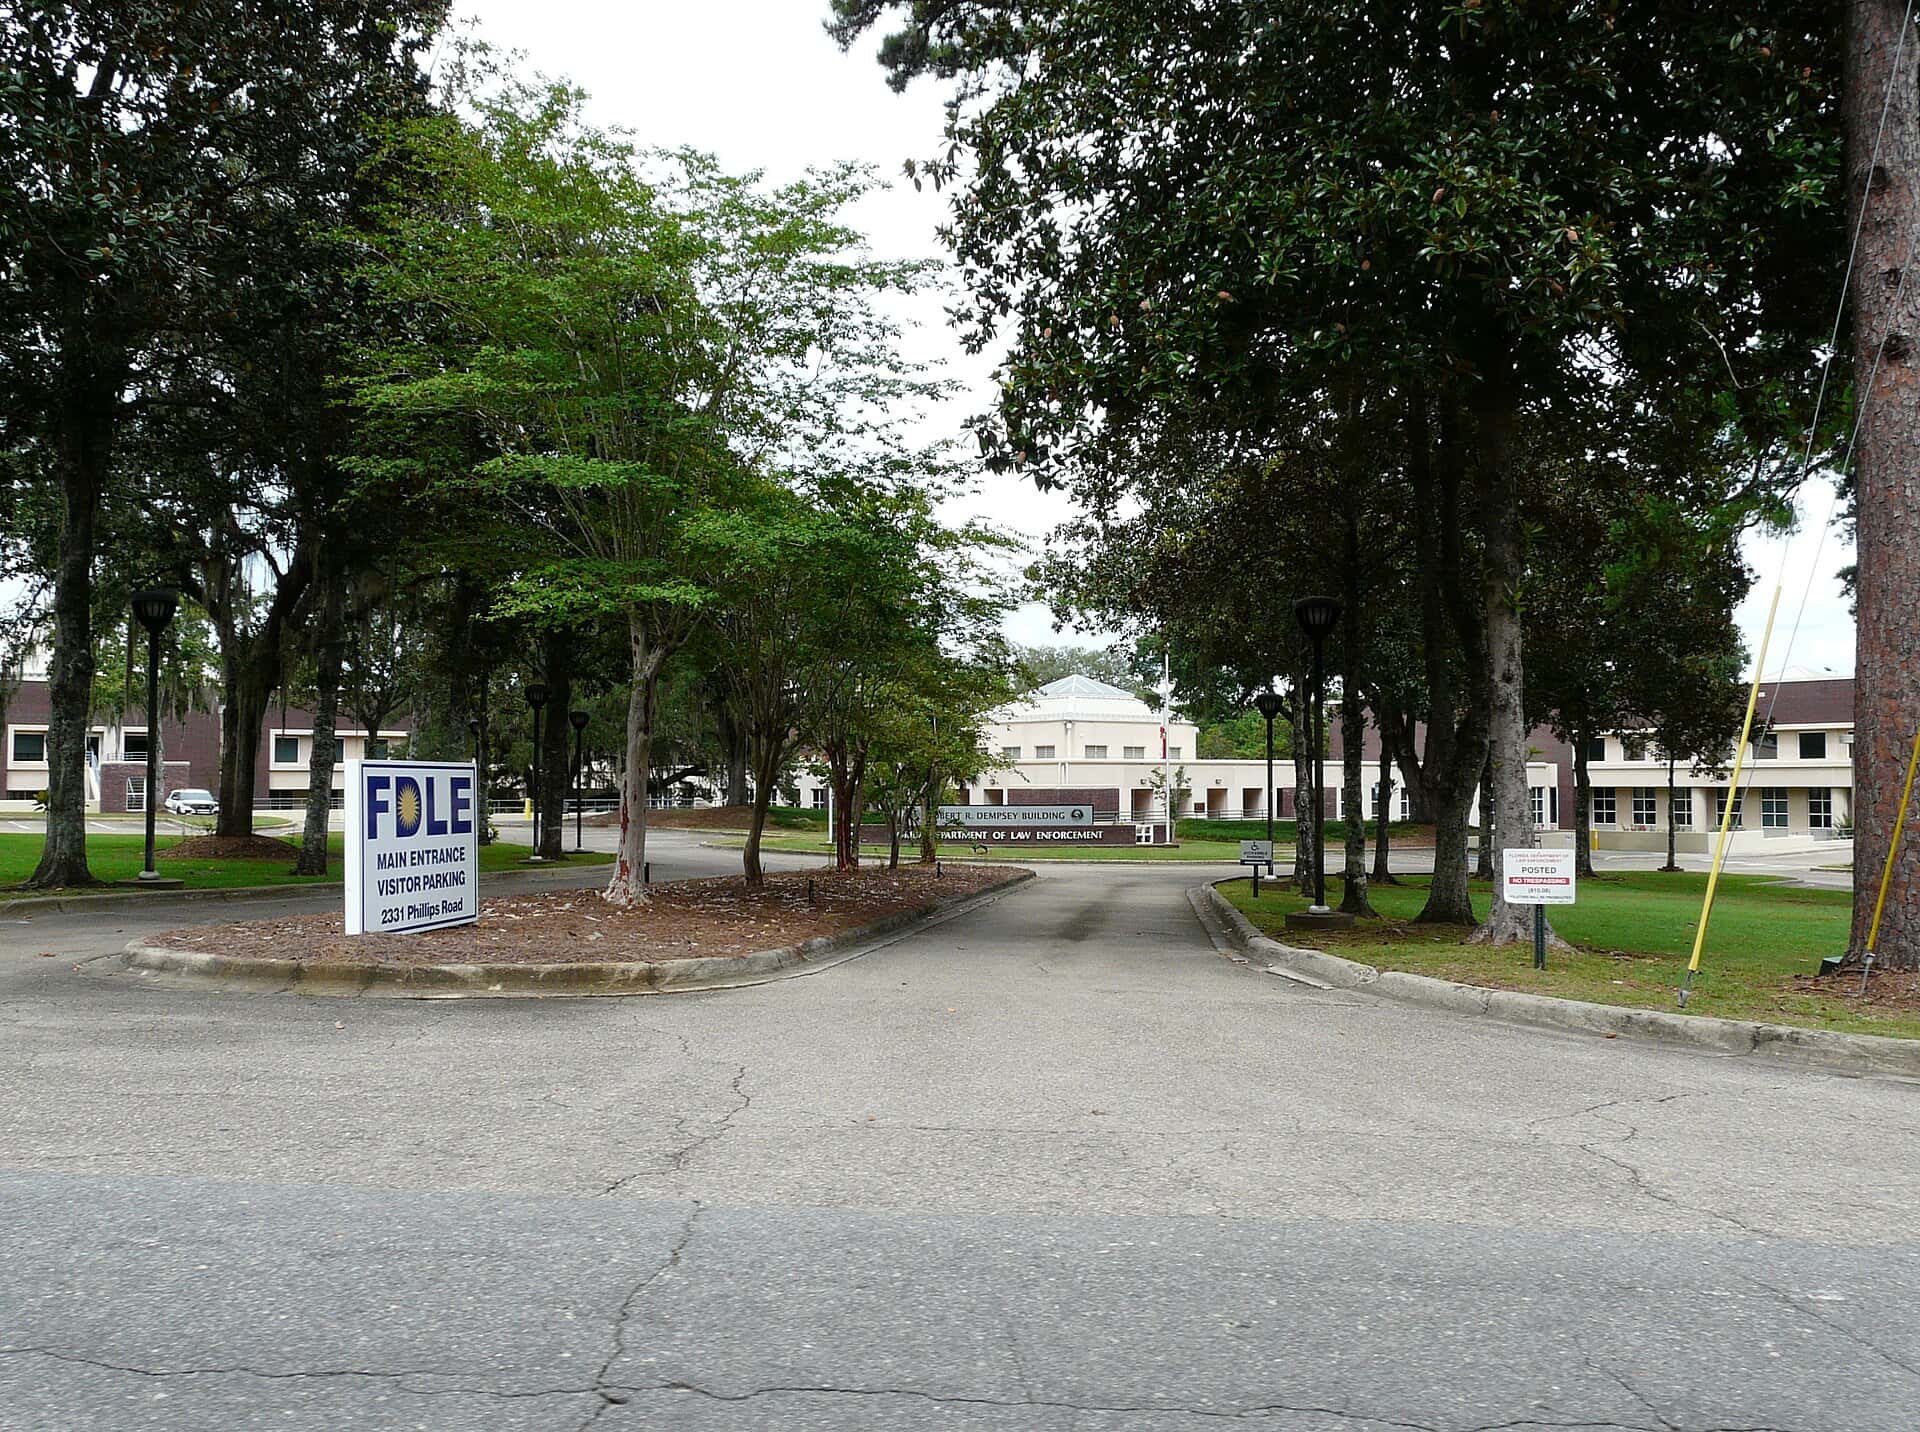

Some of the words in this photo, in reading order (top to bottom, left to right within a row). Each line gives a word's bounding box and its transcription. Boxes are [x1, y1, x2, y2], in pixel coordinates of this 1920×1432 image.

[367, 776, 472, 840] FDLE
[976, 812, 1018, 820] DEMPSEY
[1022, 812, 1065, 820] BUILDING
[992, 831, 1006, 840] OF
[1010, 831, 1031, 840] LAW
[1036, 831, 1104, 840] ENFORCEMENT
[377, 852, 407, 870] MAIN
[410, 847, 465, 867] ENTRANCE
[377, 876, 421, 897] VISITOR
[423, 870, 466, 891] PARKING
[381, 906, 405, 924] 2331
[407, 902, 440, 921] Phillips
[441, 897, 463, 914] Road
